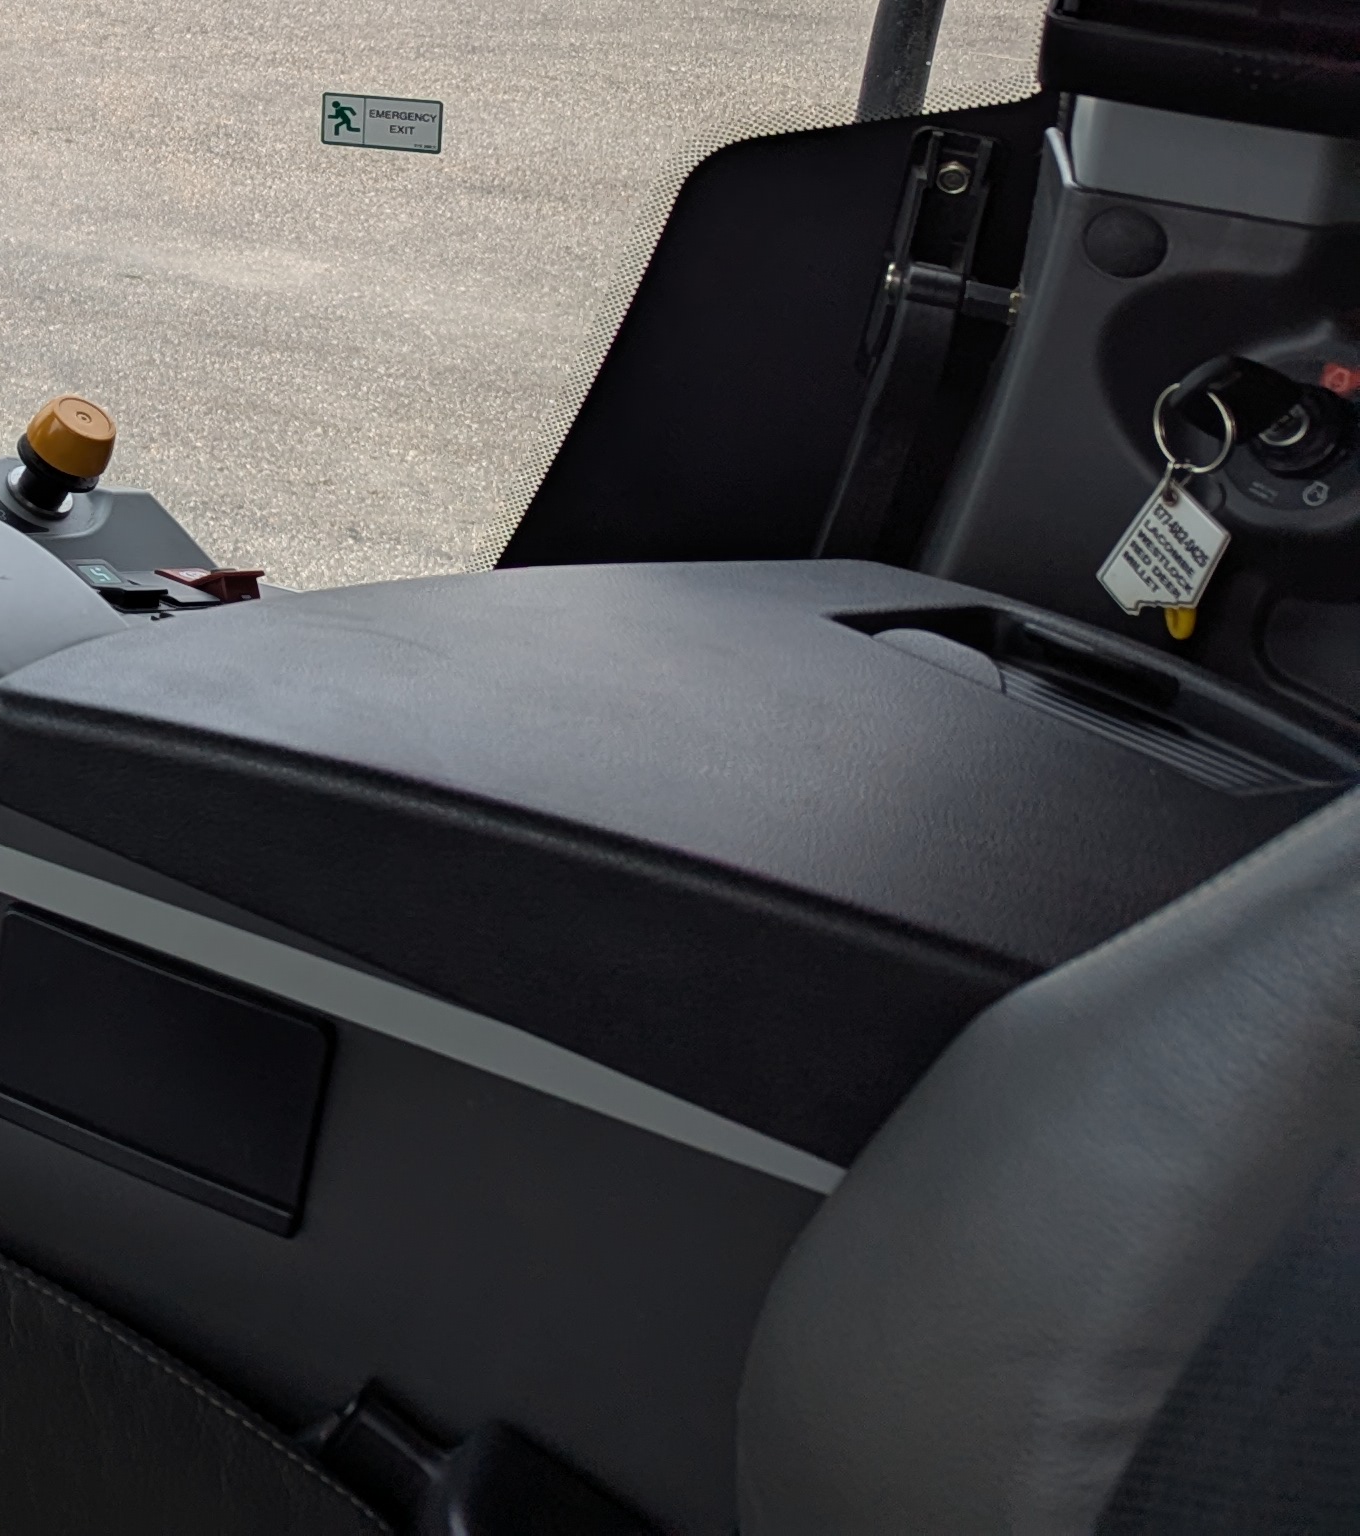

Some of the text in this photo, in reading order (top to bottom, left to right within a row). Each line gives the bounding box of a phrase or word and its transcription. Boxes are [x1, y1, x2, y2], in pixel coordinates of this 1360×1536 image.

[369, 109, 437, 124] EMERGENCY
[389, 124, 416, 135] EXIT
[1122, 550, 1160, 593] MILLET
[1130, 540, 1180, 600] RED DEER
[1137, 529, 1194, 595] WESTLOCK
[1144, 519, 1195, 577] LACOMBE
